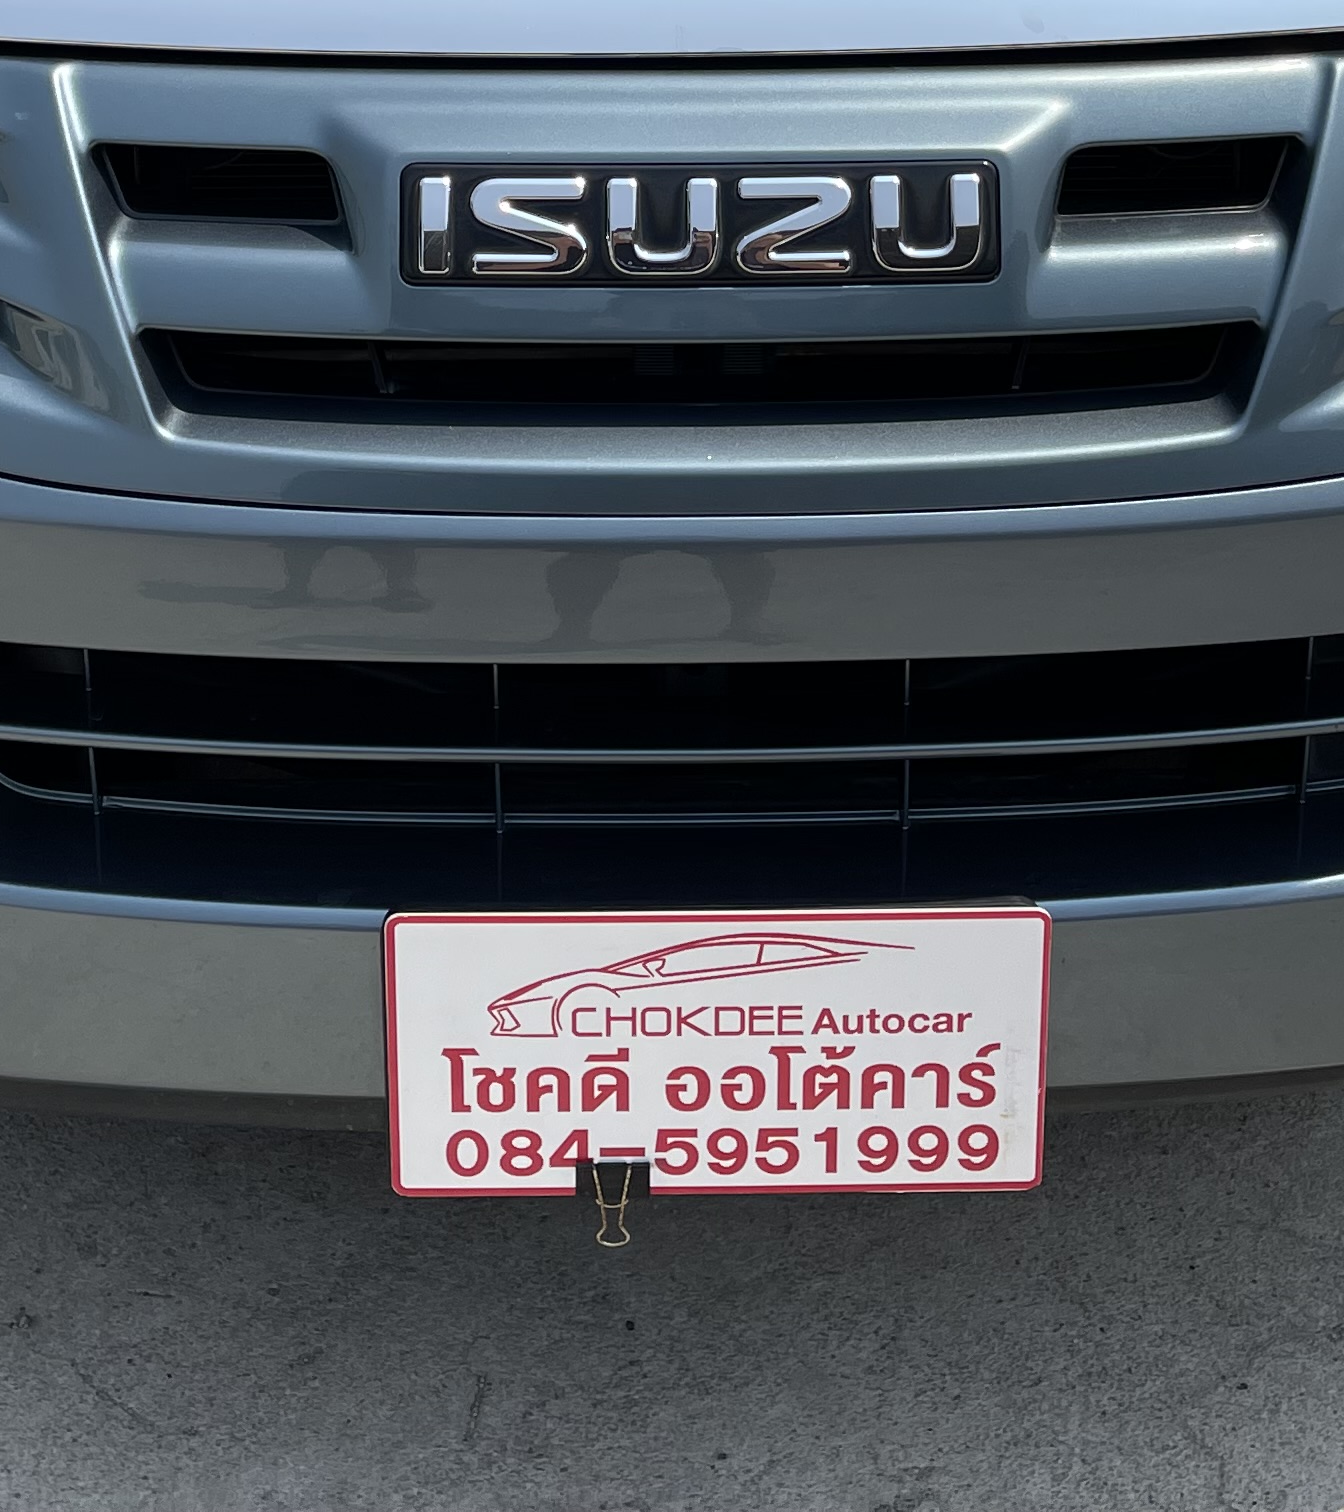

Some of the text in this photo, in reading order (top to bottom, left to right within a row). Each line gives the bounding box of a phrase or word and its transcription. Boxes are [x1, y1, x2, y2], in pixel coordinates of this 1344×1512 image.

[418, 173, 981, 275] ISUZU
[571, 1005, 974, 1038] CHOKDEE Autocar
[441, 1042, 1002, 1114] โชคดี ออโต้คาร์
[445, 1124, 1000, 1178] 084-5951999
